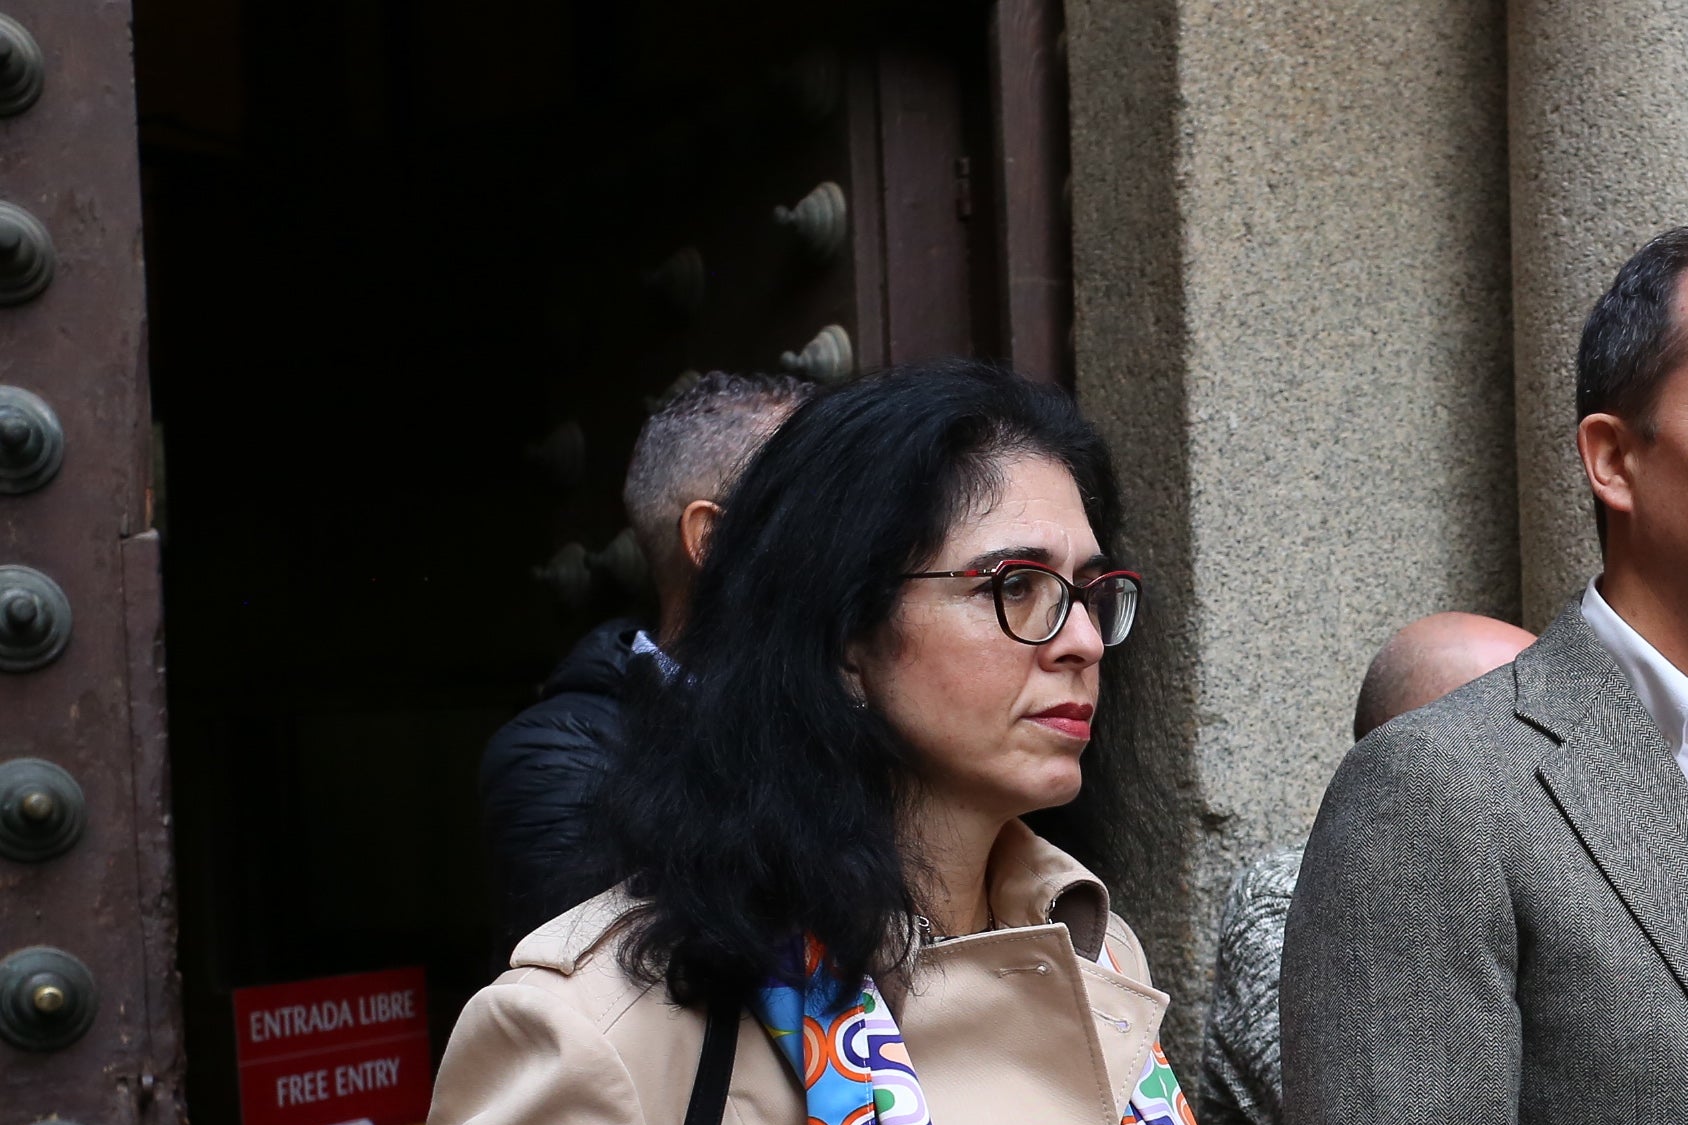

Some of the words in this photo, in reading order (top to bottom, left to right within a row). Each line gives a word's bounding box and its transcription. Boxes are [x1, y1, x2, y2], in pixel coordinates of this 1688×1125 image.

[250, 1000, 352, 1042] ENTRADA
[359, 990, 415, 1026] LIBRE
[277, 1070, 329, 1108] FREE
[335, 1057, 400, 1096] ENTRY
